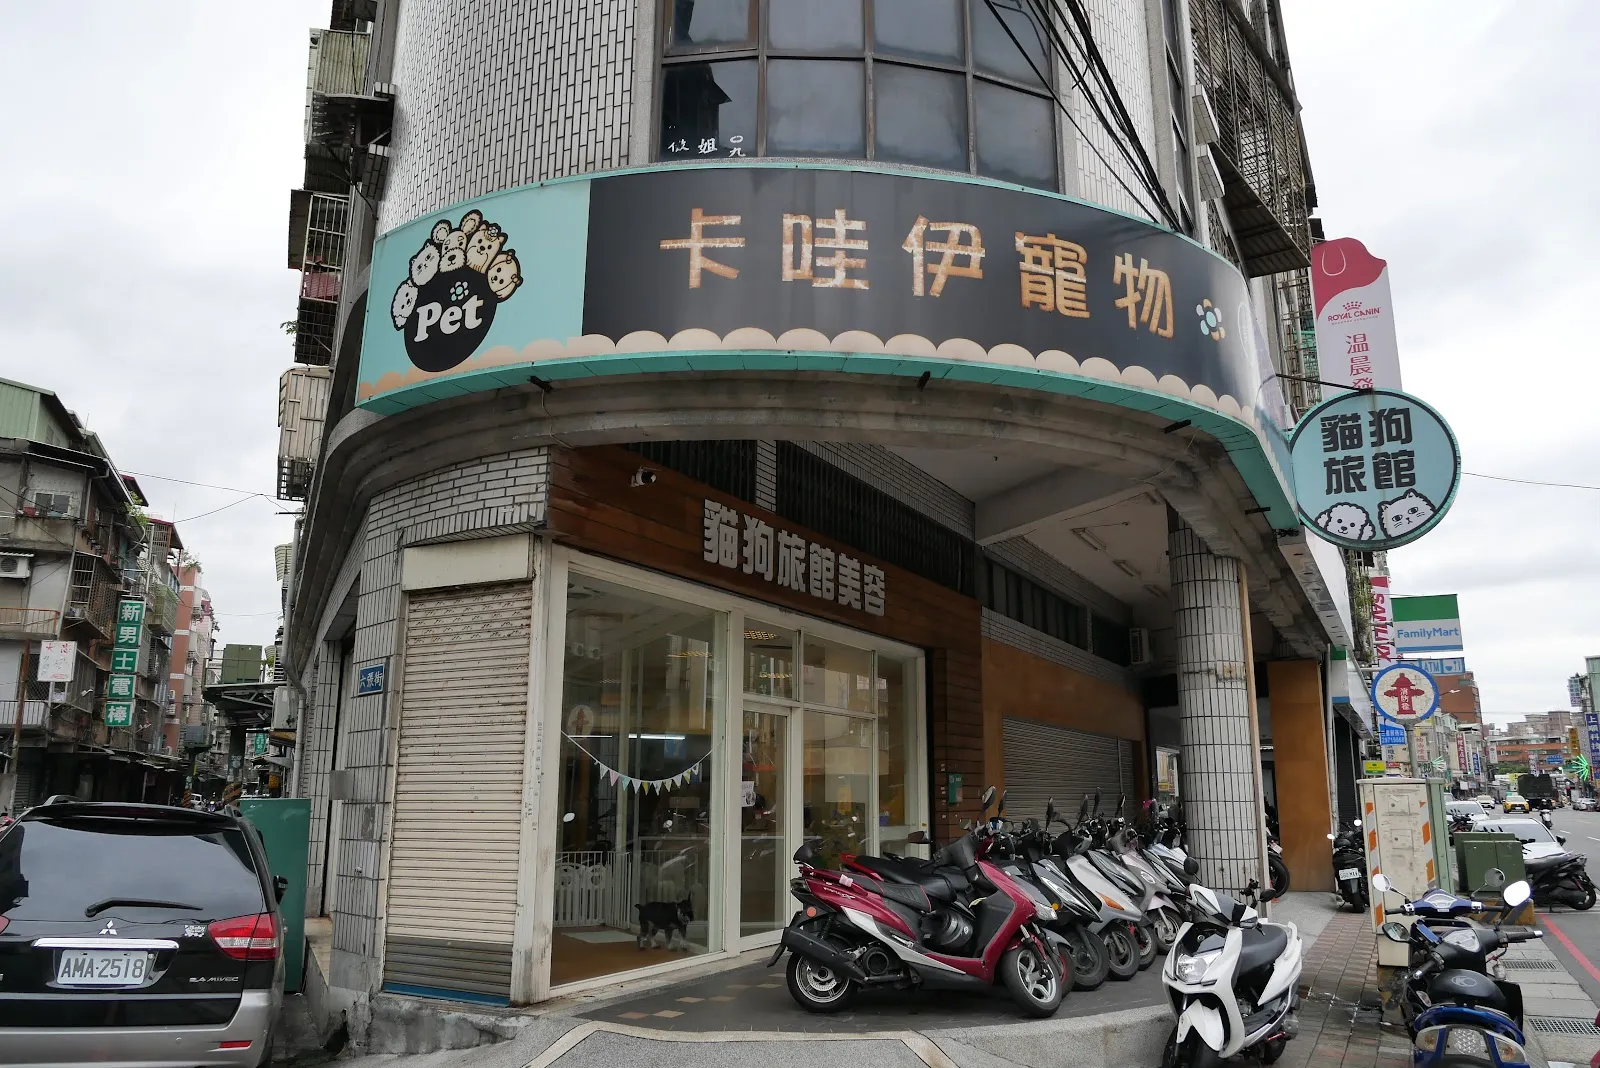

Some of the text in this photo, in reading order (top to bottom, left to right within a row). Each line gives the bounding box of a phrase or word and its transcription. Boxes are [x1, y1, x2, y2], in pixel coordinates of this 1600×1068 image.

[659, 207, 1175, 339] 卡哇伊寵物
[413, 294, 484, 343] Pet
[1327, 312, 1353, 322] ROYAL
[1353, 307, 1380, 318] CANIN
[1320, 407, 1413, 453] 貓狗
[1323, 449, 1417, 496] 旅館
[703, 498, 886, 617] 貓狗旅館美容
[1397, 627, 1460, 640] FamilyMart
[107, 603, 141, 724] 新男士電棒
[1424, 661, 1440, 672] ATM
